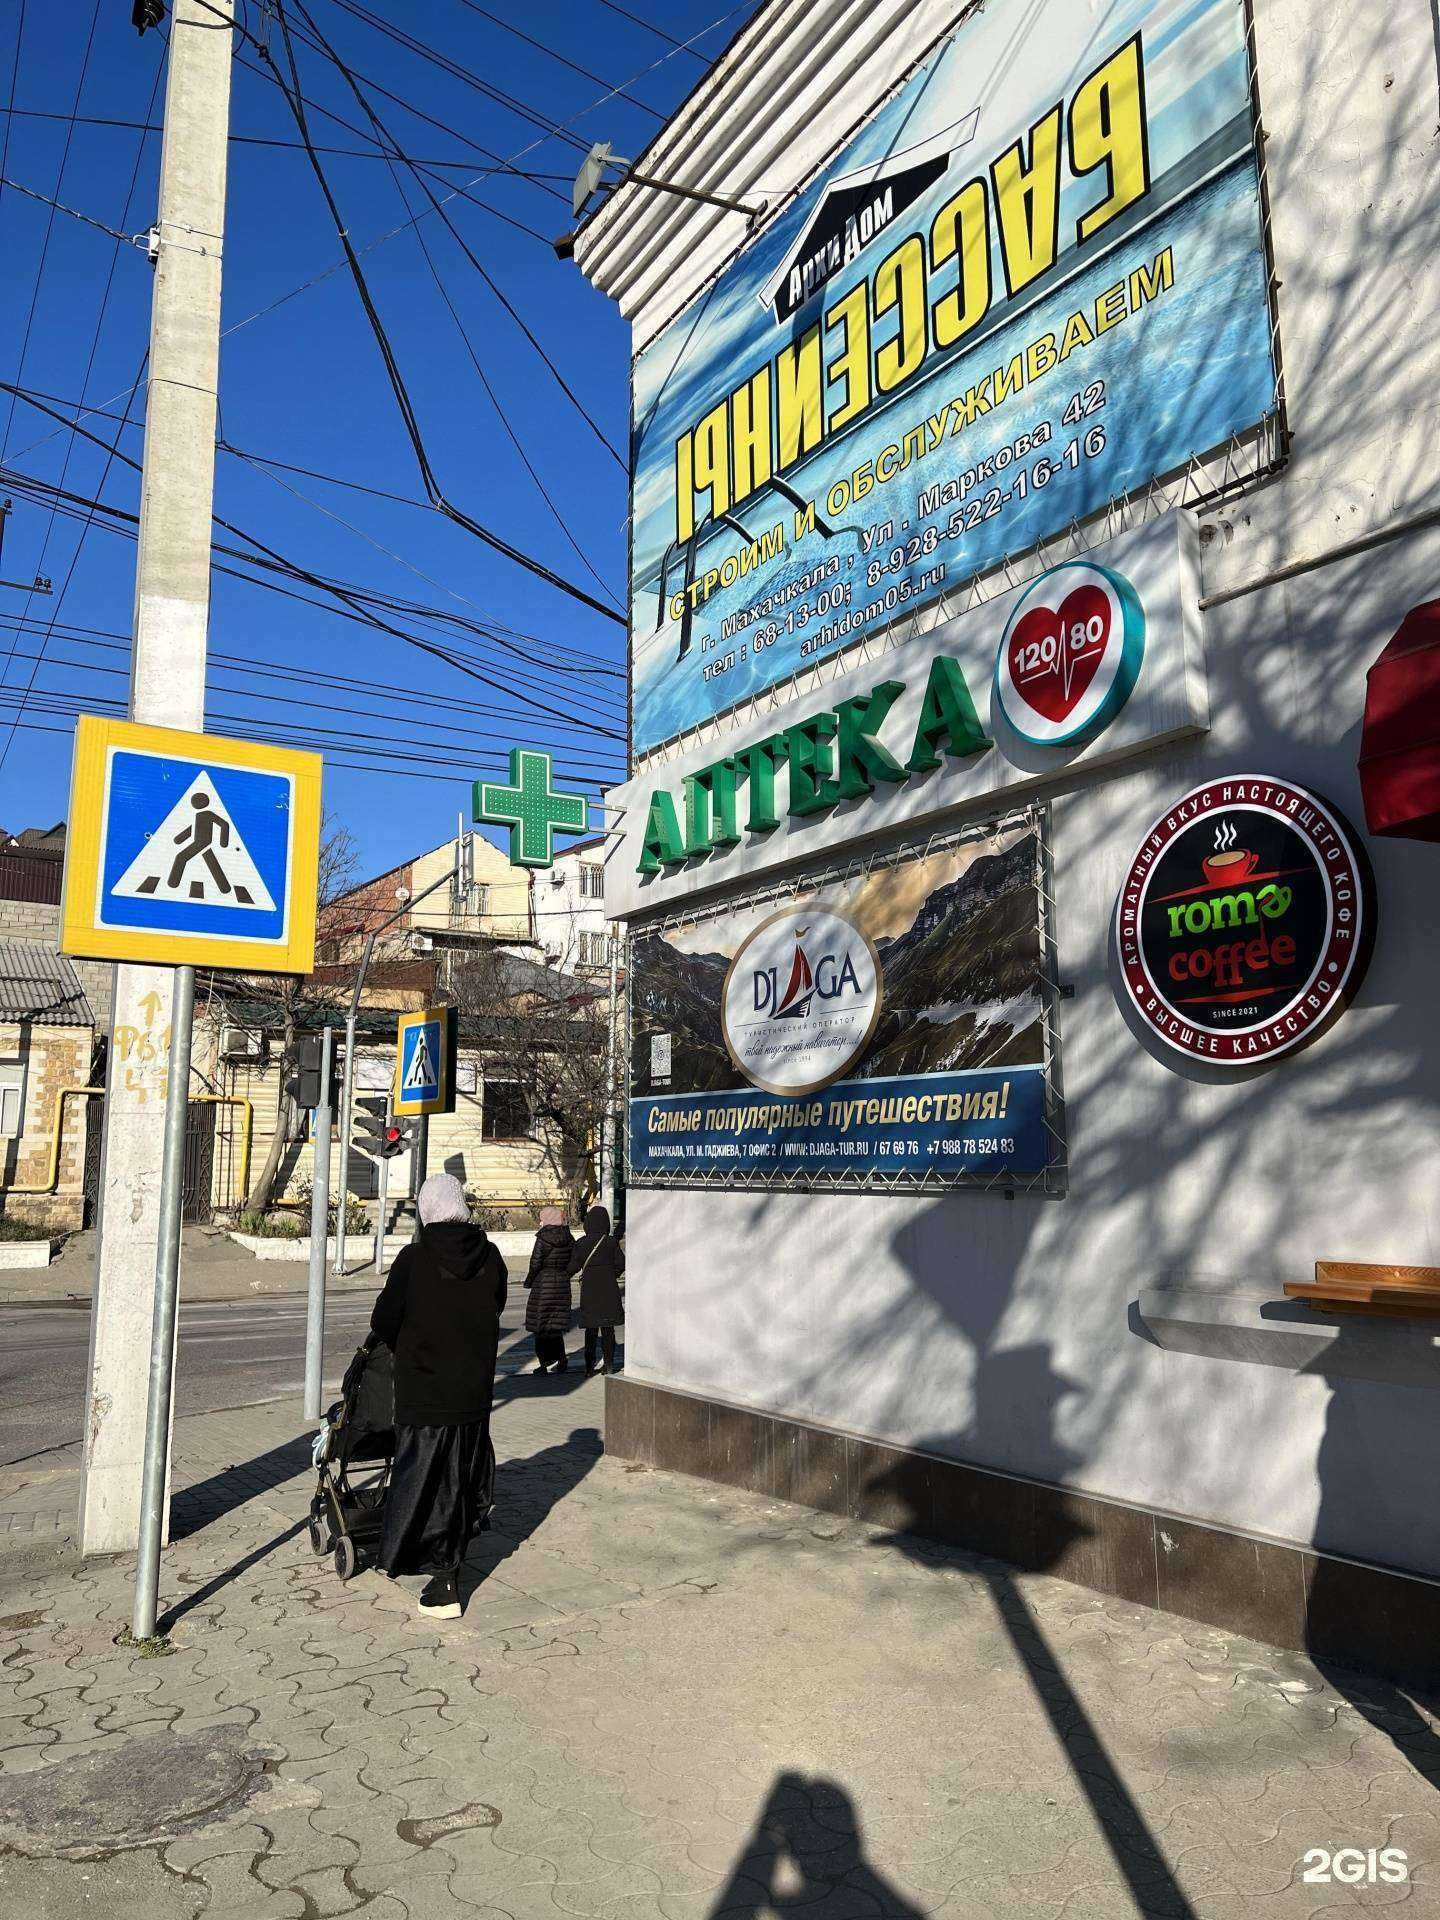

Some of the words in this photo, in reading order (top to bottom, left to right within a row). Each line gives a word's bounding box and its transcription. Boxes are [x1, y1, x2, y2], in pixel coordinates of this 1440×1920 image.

[669, 522, 784, 622] СТРОИМ
[794, 500, 816, 543] И
[826, 245, 1175, 517] ОБСЛУЖИВАЕМ
[720, 555, 840, 643] Махачкала
[917, 421, 1053, 519] Маркова
[1062, 380, 1107, 427] 42
[866, 425, 1107, 588] 8-928-522-16-16
[800, 562, 946, 658] arhidom05.ru
[1014, 636, 1057, 674] 120
[1070, 615, 1104, 650] 80
[636, 655, 995, 875] АПТЕКА
[1123, 834, 1163, 966] АРОМАТНЫЙ
[1166, 793, 1211, 832] ВКУС
[1223, 785, 1341, 861] НАСТОЯЩЕГО
[1333, 870, 1352, 940] КОФЕ
[1168, 934, 1297, 988] coffee
[812, 1016, 856, 1029] ОПЕРАТОР
[1146, 998, 1218, 1053] ВЫСШЕЕ
[1233, 979, 1331, 1054] КАЧЕСТВО
[1212, 1008, 1237, 1019] SINCE
[1238, 1006, 1258, 1016] 2021
[648, 1105, 702, 1133] Самые
[705, 1102, 823, 1136] популярные
[827, 1081, 1011, 1133] путешествия!
[648, 1145, 686, 1158] МАХАЧКАЛА,
[704, 1144, 742, 1158] ГАДЖИЕВА,
[742, 1145, 747, 1156] 7
[748, 1144, 771, 1157] ОФИС
[771, 1144, 777, 1155] 2
[809, 1141, 869, 1156] DJAGA-TUR.RU
[879, 1140, 893, 1155] 67
[893, 1140, 905, 1155] 69
[906, 1140, 919, 1155] 76
[926, 1140, 940, 1155] +7
[942, 1139, 961, 1155] 988
[963, 1139, 976, 1154] 78
[978, 1138, 998, 1154] 524
[1000, 1138, 1015, 1154] 83
